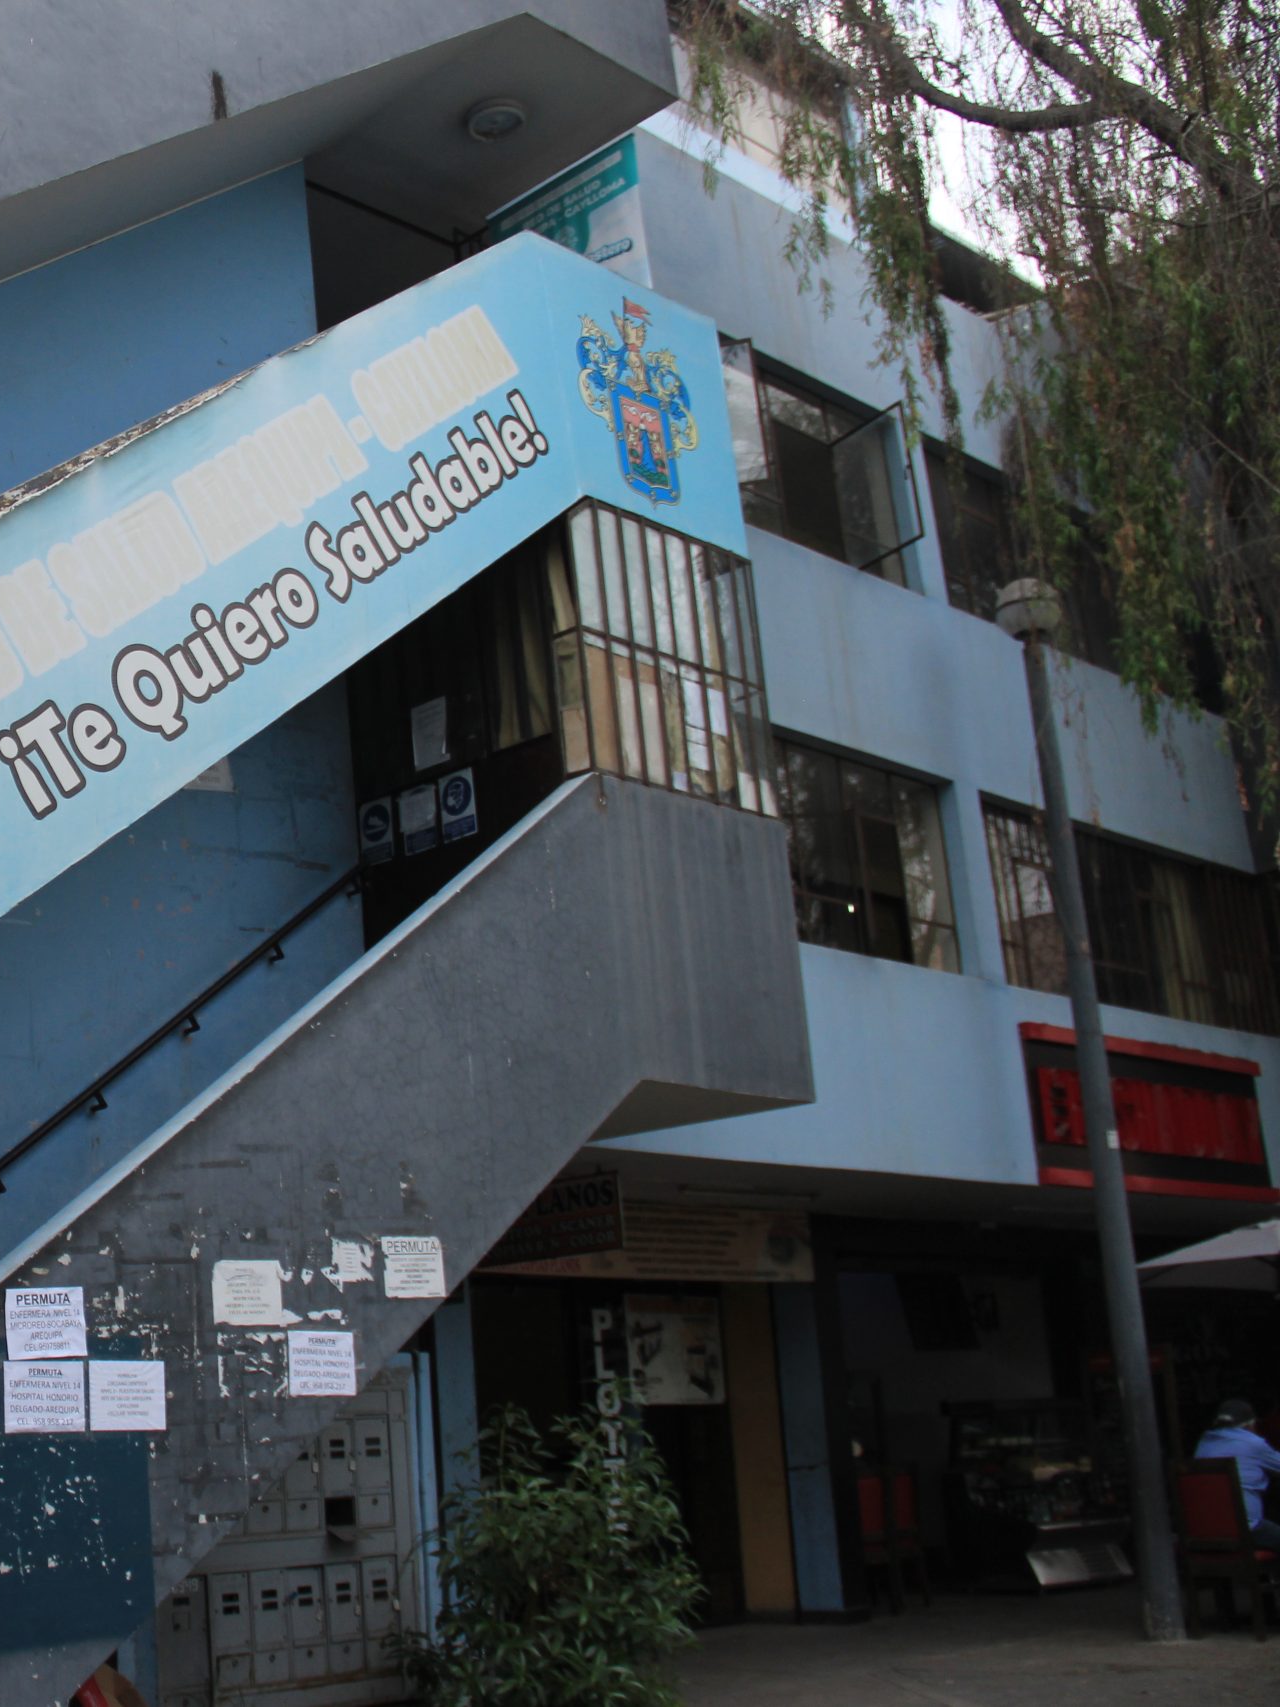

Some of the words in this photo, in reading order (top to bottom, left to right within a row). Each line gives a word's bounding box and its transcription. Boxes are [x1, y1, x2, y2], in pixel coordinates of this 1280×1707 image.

[111, 567, 319, 742] Quiero
[304, 388, 549, 603] Saludable!
[528, 1179, 615, 1217] LANOS
[385, 1240, 439, 1254] PERMUTA
[15, 1292, 71, 1306] PERMUTA
[29, 1330, 64, 1341] AREQUIPA
[27, 1367, 63, 1377] PERMUTA
[8, 1379, 51, 1389] ENFERMERA
[51, 1381, 71, 1389] NIVEL
[72, 1381, 81, 1390] 14
[10, 1391, 44, 1401] HOSPITAL
[45, 1392, 79, 1402] HONORIO
